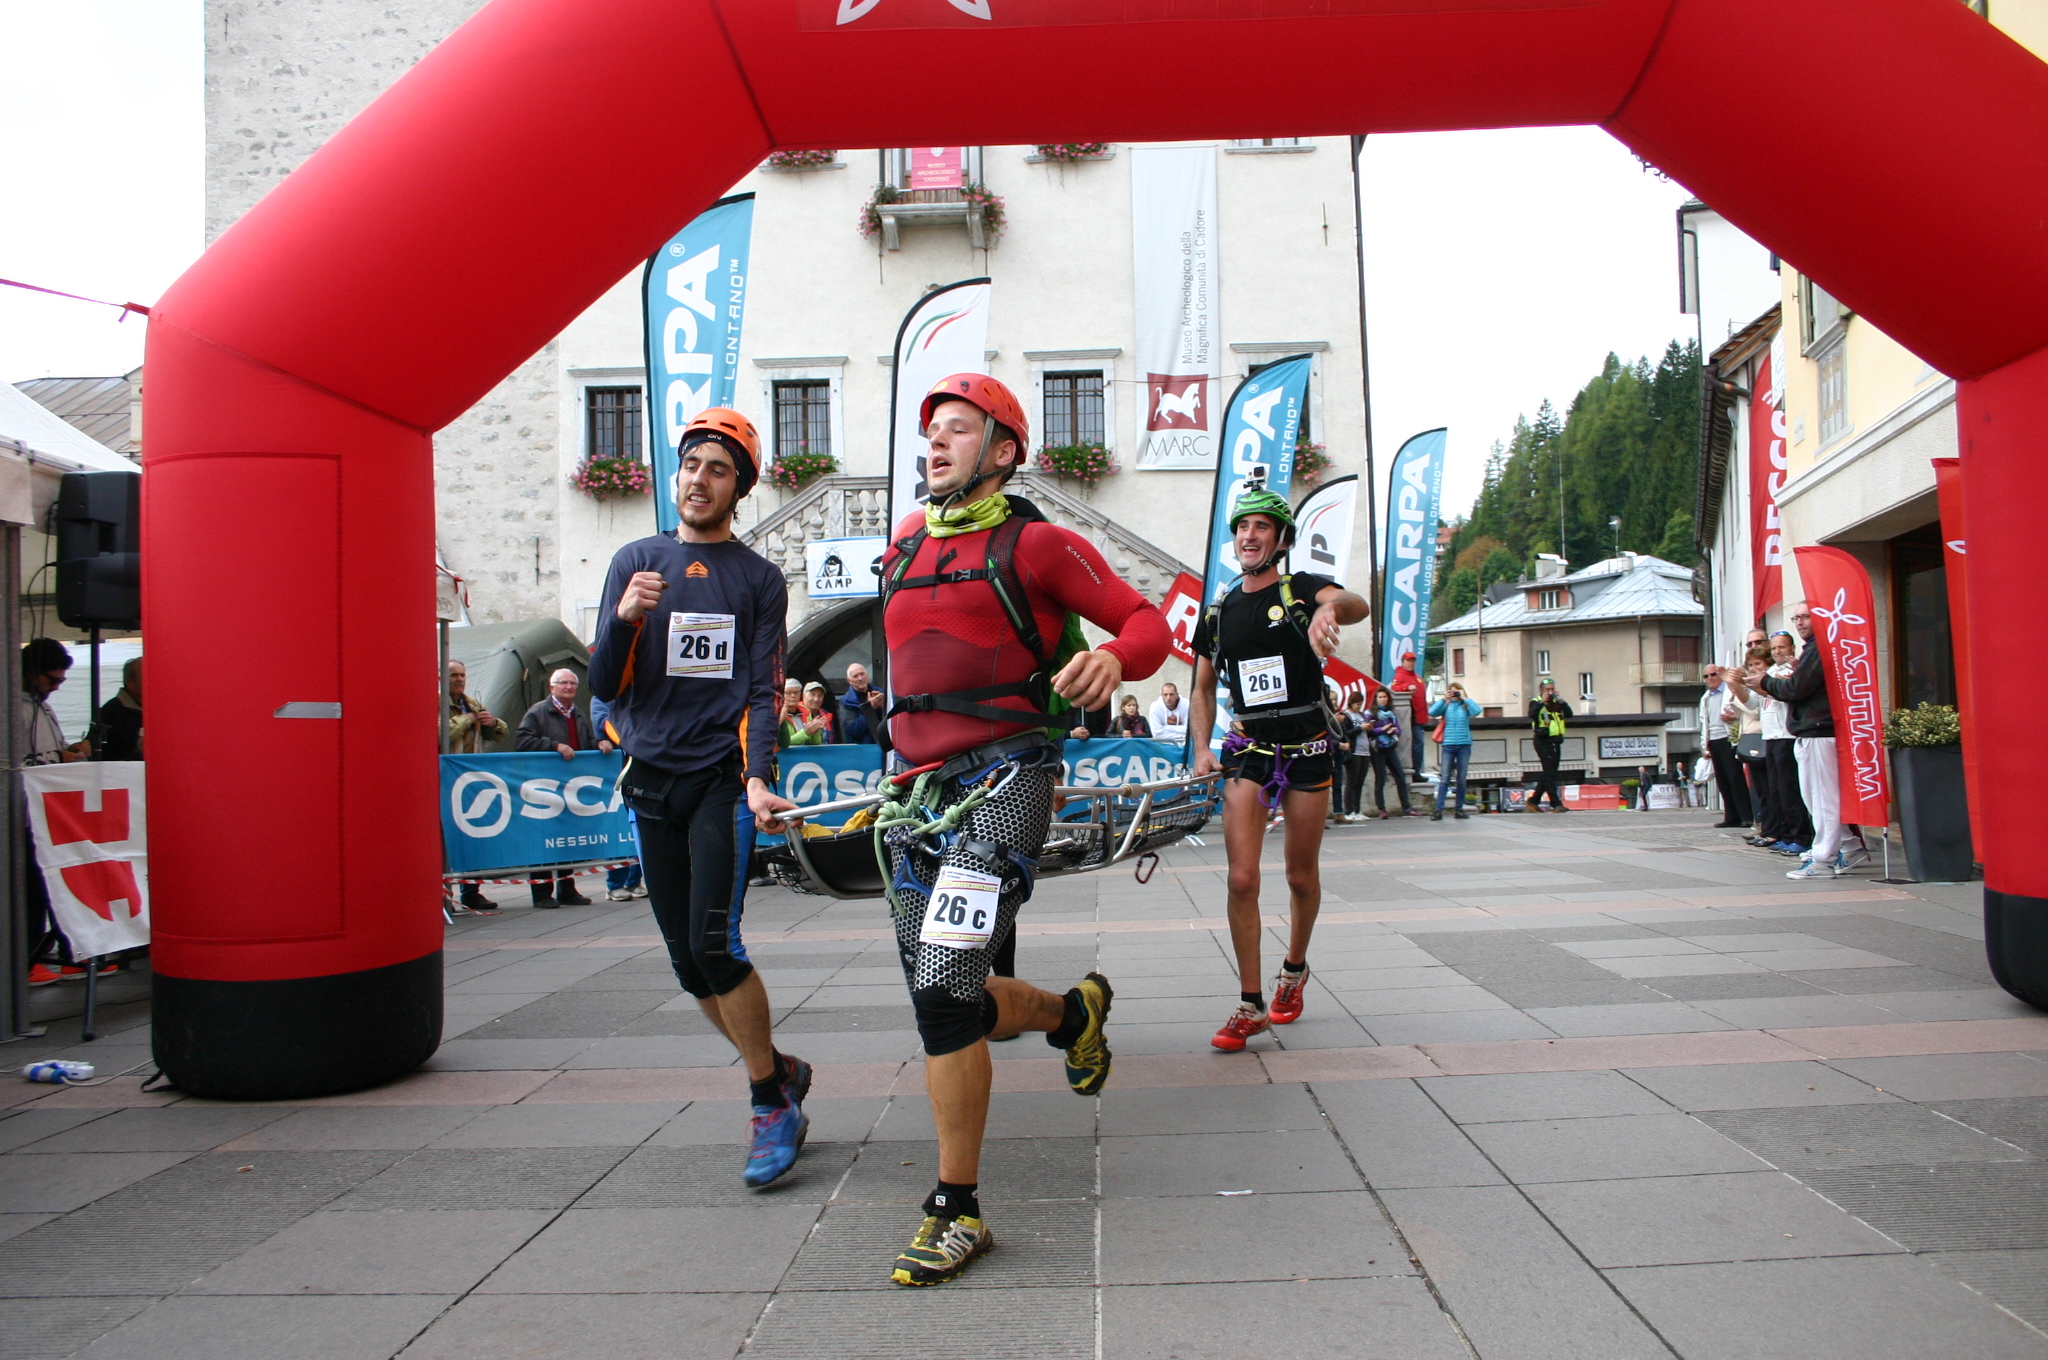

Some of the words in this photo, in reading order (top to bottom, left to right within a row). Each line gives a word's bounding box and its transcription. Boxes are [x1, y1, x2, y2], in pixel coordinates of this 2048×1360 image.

[1180, 231, 1192, 256] della
[1194, 209, 1206, 247] Cadore
[1195, 249, 1207, 259] di
[1181, 258, 1194, 327] Archeologico
[1195, 262, 1208, 311] Comunità
[1182, 329, 1193, 364] Museo
[1196, 313, 1210, 364] Magnifica
[1145, 435, 1210, 457] MARC
[1065, 545, 1102, 585] SALOMON
[815, 578, 852, 589] CAMP
[1417, 603, 1429, 656] NESSUN
[1423, 555, 1434, 595] LUOGO
[680, 634, 711, 660] 26
[715, 640, 728, 661] d
[1248, 673, 1269, 693] 26
[1272, 675, 1282, 689] b
[1604, 738, 1622, 749] Casa
[1625, 737, 1635, 748] del
[545, 834, 609, 849] NESSUN
[934, 892, 968, 926] 26
[972, 909, 987, 930] c
